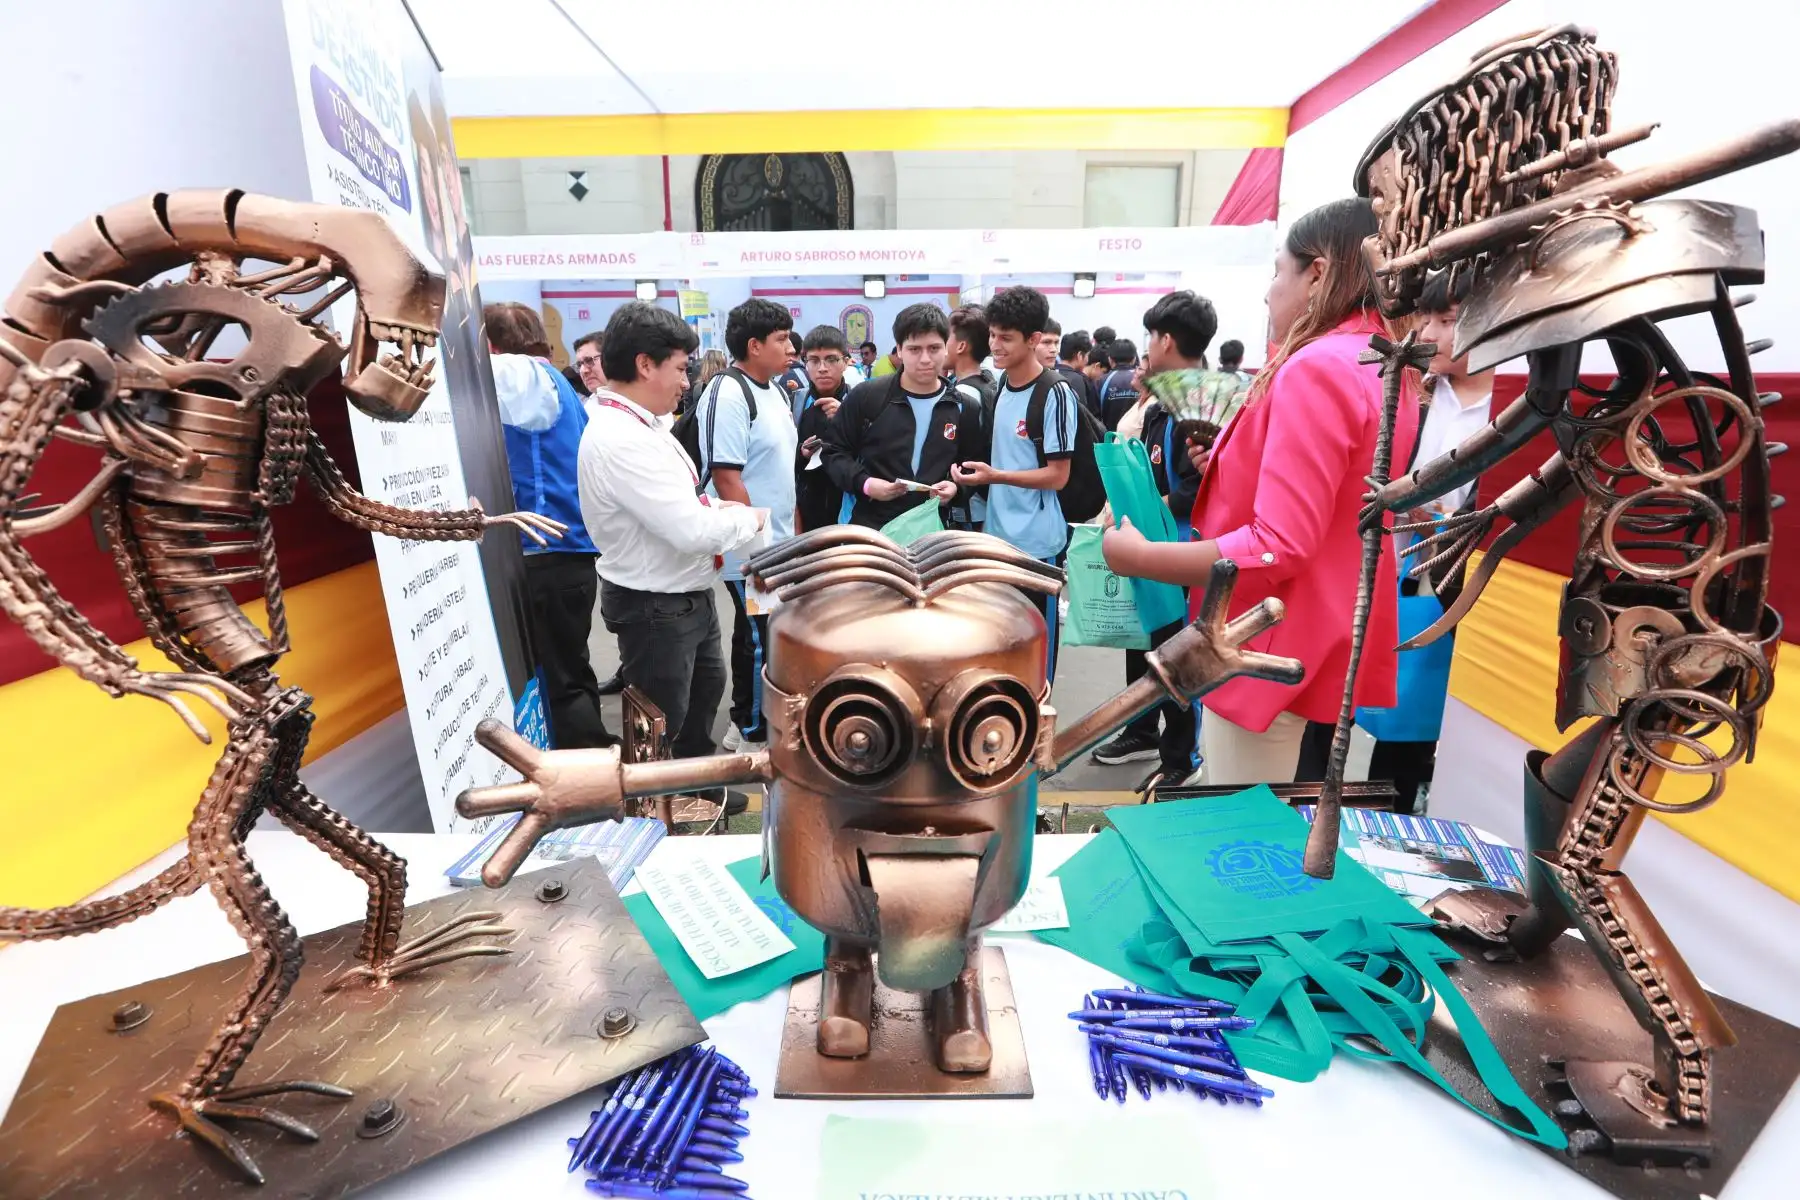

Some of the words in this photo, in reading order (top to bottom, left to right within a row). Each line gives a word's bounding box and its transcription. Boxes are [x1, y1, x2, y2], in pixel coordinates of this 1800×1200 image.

[1099, 238, 1142, 250] FESTO
[478, 255, 502, 266] LAS
[506, 253, 564, 266] FUERZAS
[568, 252, 637, 265] ARMADAS
[740, 251, 791, 262] ARTURO
[795, 250, 856, 262] SABROSO
[859, 249, 926, 261] MONTOYA
